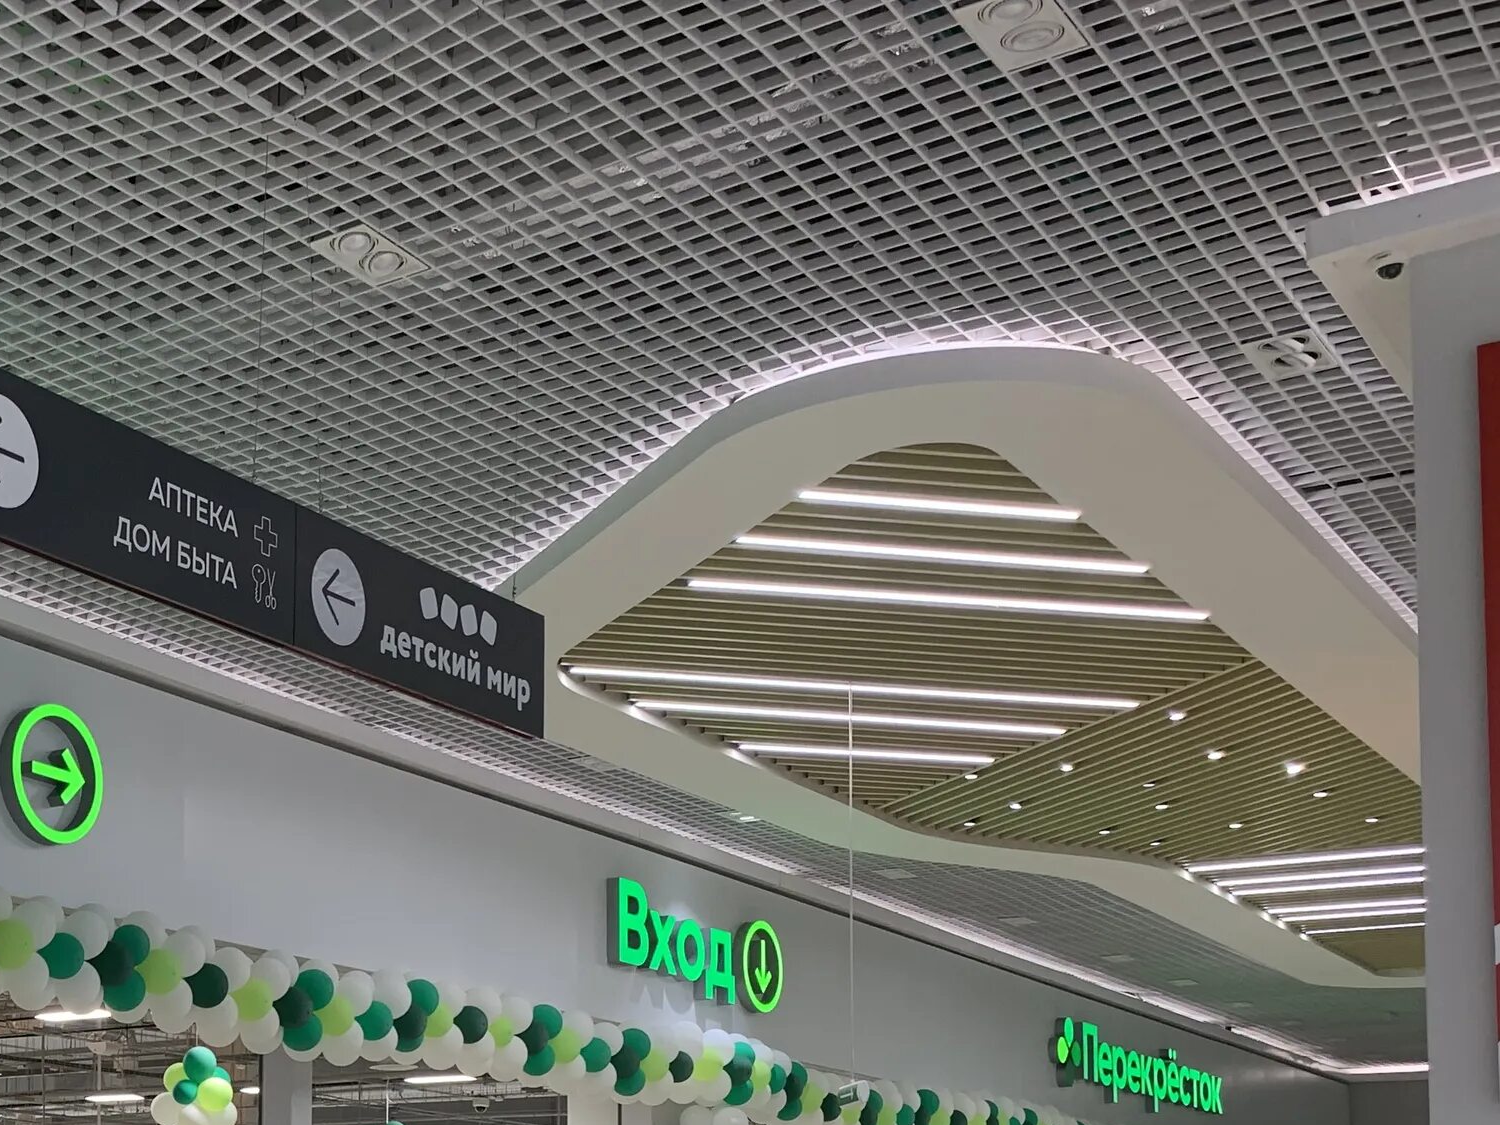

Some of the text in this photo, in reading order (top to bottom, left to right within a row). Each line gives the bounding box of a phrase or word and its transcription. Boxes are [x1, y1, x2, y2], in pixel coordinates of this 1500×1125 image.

[148, 476, 239, 538] АПТЕКА
[113, 515, 238, 589] ДОМ БЫТА
[380, 624, 531, 712] детский мир
[613, 876, 736, 1006] Вход
[1080, 1021, 1224, 1115] Перекрёсток
